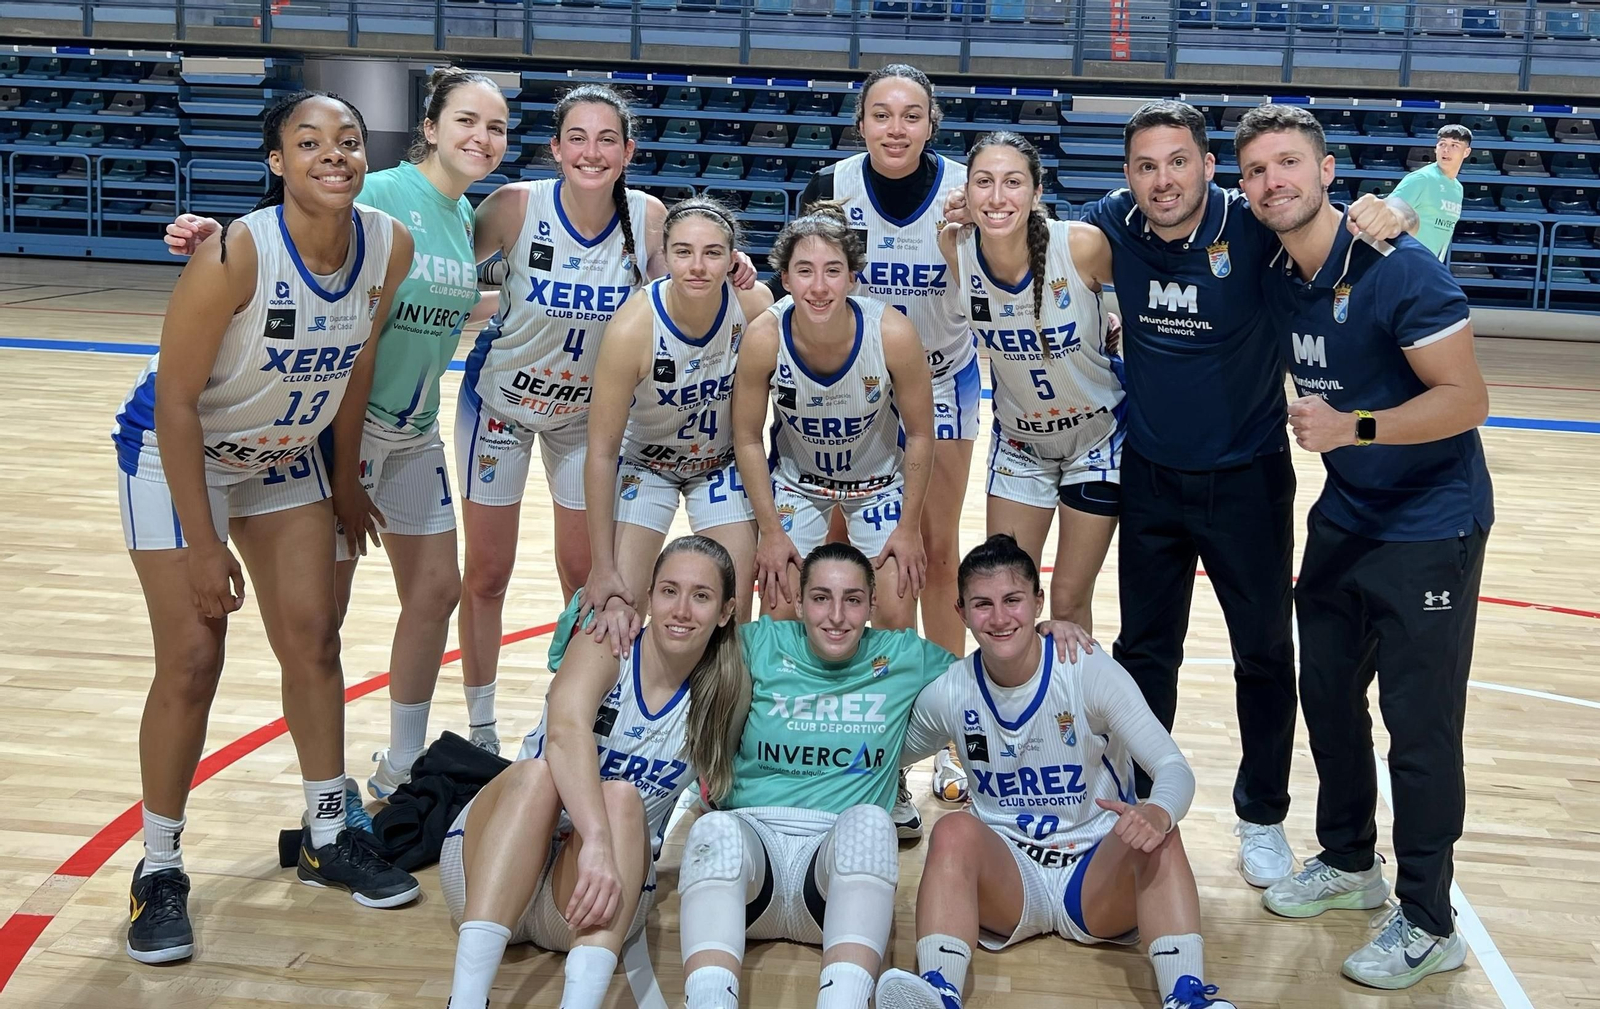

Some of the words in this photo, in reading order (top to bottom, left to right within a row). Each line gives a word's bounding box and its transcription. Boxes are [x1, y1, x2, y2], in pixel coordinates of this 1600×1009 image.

[409, 251, 478, 290] XERE
[429, 284, 448, 296] CLUB
[525, 275, 631, 313] XEREZ
[868, 286, 893, 295] CLUB
[895, 287, 946, 297] DEPORTIVO
[545, 308, 573, 320] CLUB
[1138, 314, 1213, 330] MundoMÓVIL
[562, 328, 586, 362] 4
[977, 321, 1081, 352] XEREZ
[1157, 325, 1196, 337] Network
[259, 340, 368, 374] XERE
[1003, 353, 1026, 361] CLUB
[1028, 344, 1082, 361] DEORTIVO
[282, 374, 311, 383] CLUB
[656, 368, 736, 407] XERE
[1029, 369, 1056, 401] 5
[273, 390, 330, 426] 13
[520, 397, 549, 412] FIT
[677, 400, 701, 412] CLUB
[677, 410, 718, 440] 24
[802, 435, 826, 446] CLUB
[863, 500, 902, 531] 44
[767, 692, 887, 722] XEREZ
[786, 721, 817, 731] CLUB
[819, 722, 886, 734] DEPORTIVO
[597, 745, 687, 791] EREZ
[757, 740, 885, 774] INVERCAR
[972, 764, 1087, 798] XEREZ
[999, 797, 1026, 807] CLUB
[1028, 791, 1088, 807] DEPORTIVO
